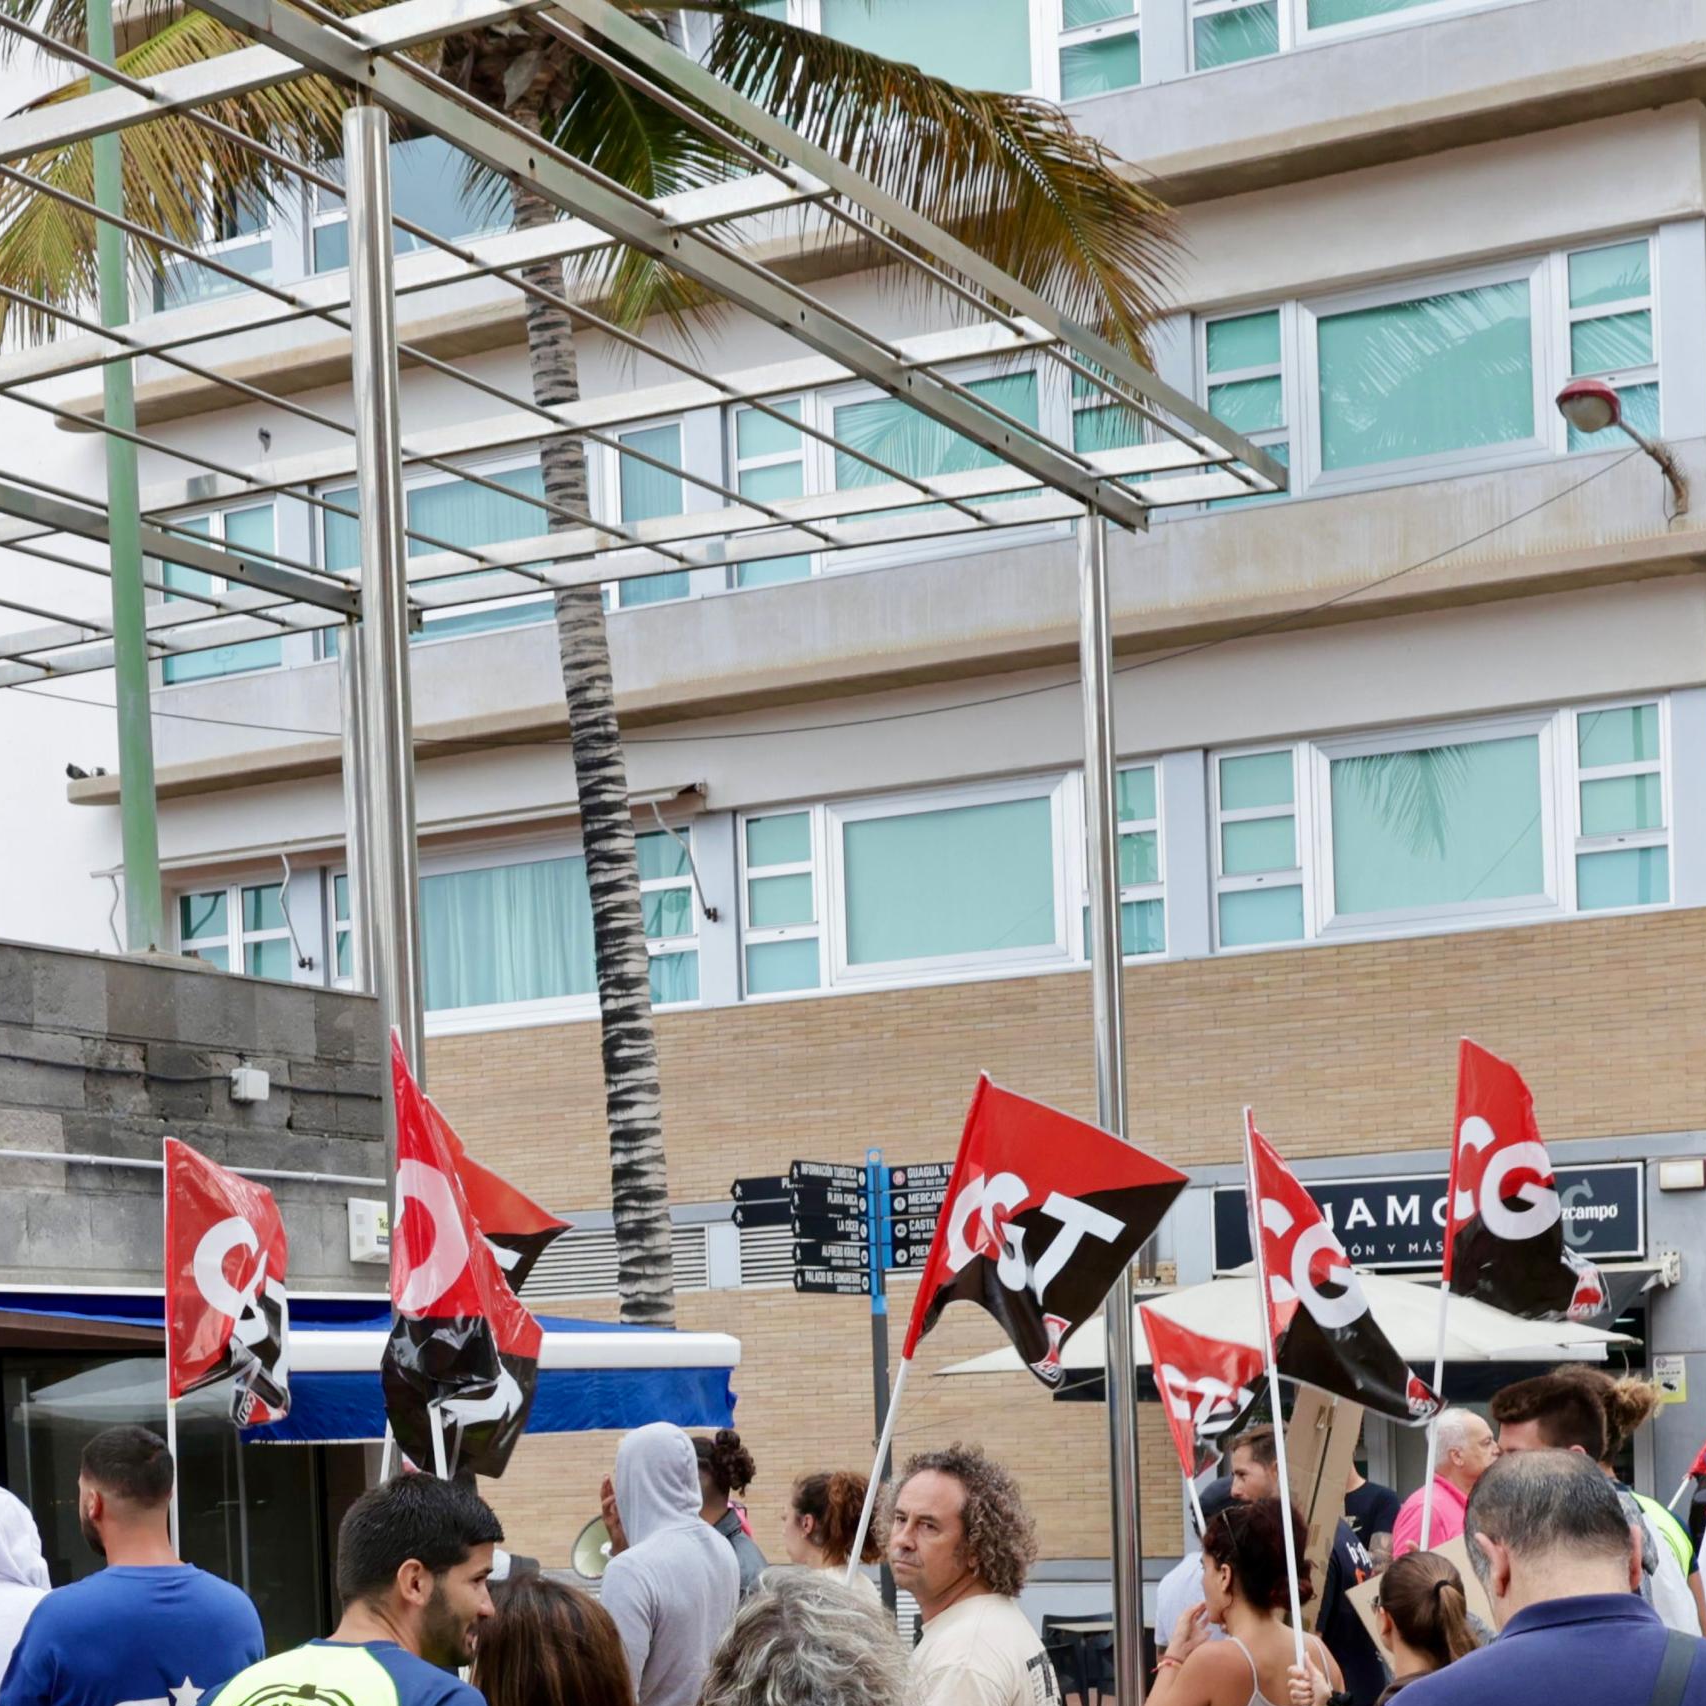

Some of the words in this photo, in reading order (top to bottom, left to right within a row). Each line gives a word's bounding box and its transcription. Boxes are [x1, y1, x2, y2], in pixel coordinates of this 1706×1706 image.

[907, 1165, 940, 1179] GUAGUA
[908, 1217, 937, 1232] CASTIL
[909, 1245, 931, 1259] POEM
[1409, 1237, 1444, 1254] MÁS
[805, 1270, 826, 1284] PALACIO
[826, 1272, 834, 1284] DE
